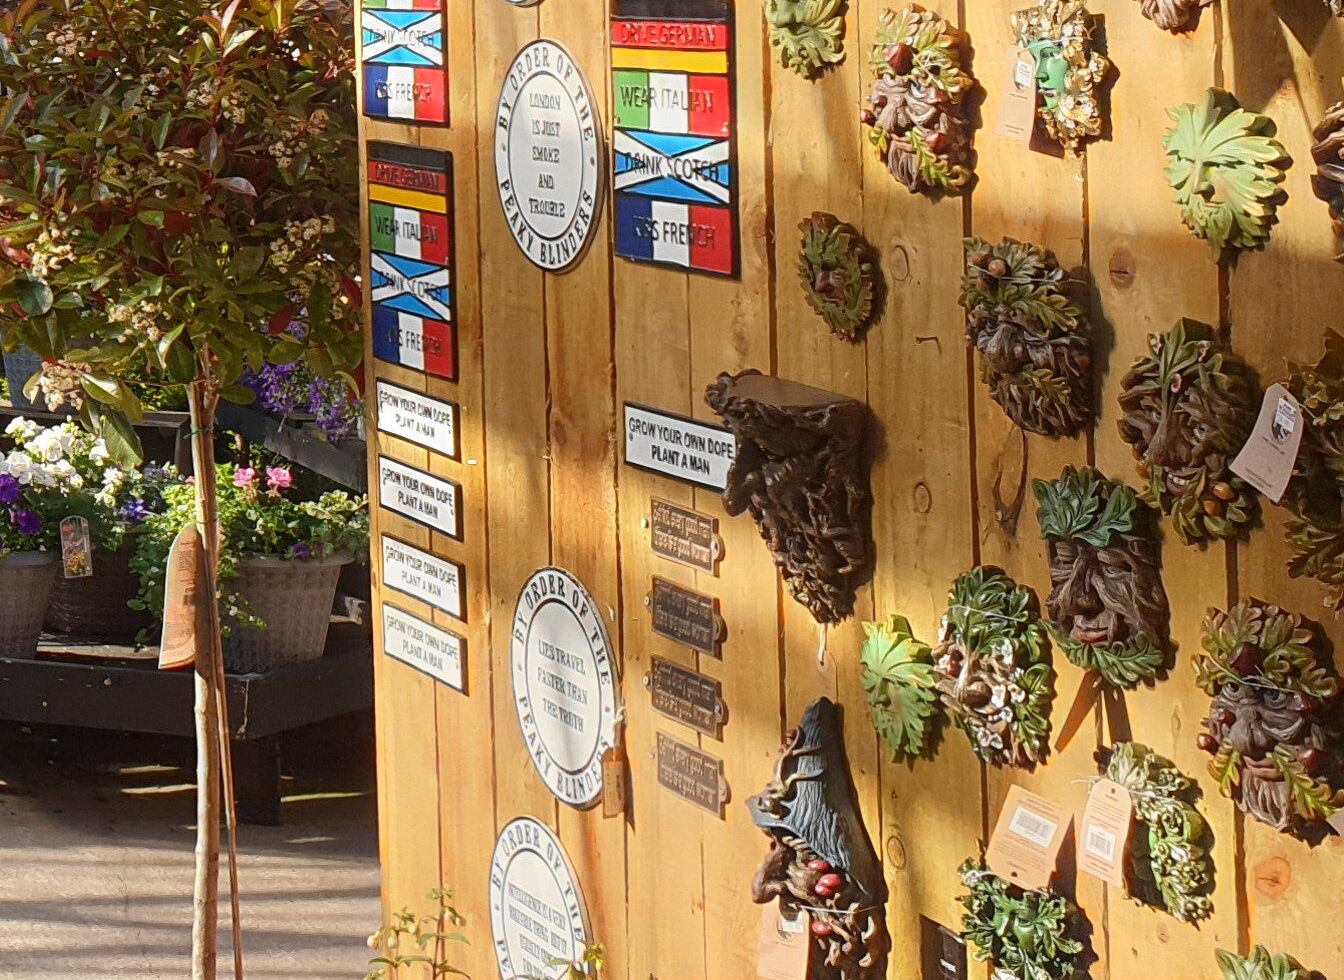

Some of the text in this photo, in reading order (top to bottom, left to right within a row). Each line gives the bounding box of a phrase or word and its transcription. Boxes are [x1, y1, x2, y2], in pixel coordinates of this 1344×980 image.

[621, 23, 716, 47] DRIVE GERMAN
[498, 46, 594, 142] BY ORDER OF THE
[529, 92, 561, 111] LONDON
[620, 85, 714, 114] WEAR ITALIAN
[532, 120, 561, 138] IS JUST
[532, 145, 561, 164] SMOKE
[624, 152, 719, 181] DRINK SCOTCH
[538, 173, 554, 190] AND
[500, 178, 593, 266] PEAKY BLINDERS
[528, 197, 566, 218] TROUBLE
[375, 215, 439, 245] WEAR ITALIAN
[662, 221, 715, 249] FRENCH
[407, 277, 442, 302] SCOTCH
[405, 330, 442, 355] FRENCH
[380, 390, 451, 427] GROW YOUR OWN DOPE
[396, 414, 435, 438] PLANT A MAN
[629, 417, 735, 459] GROW YOUR OWN DOPE
[651, 445, 710, 475] PLANT A MAN
[382, 467, 453, 507] GROW YOUR OWN DOPE
[398, 491, 438, 519] PLANT A MAN
[386, 546, 457, 587] GROW YOUR OWN DOPE
[402, 570, 442, 597] PLANT A MAN
[387, 615, 458, 659] GROW YOUR OWN DOPE
[515, 573, 611, 686] BY ORDER OF THE
[403, 639, 443, 671] PLANT A MAN
[538, 638, 586, 676] LIES TRAVEL
[537, 666, 588, 706] FASTER THAN
[542, 697, 584, 733] THE TRUTH
[518, 696, 552, 777] PEAKY
[492, 823, 585, 941] BY ORDER OF THE
